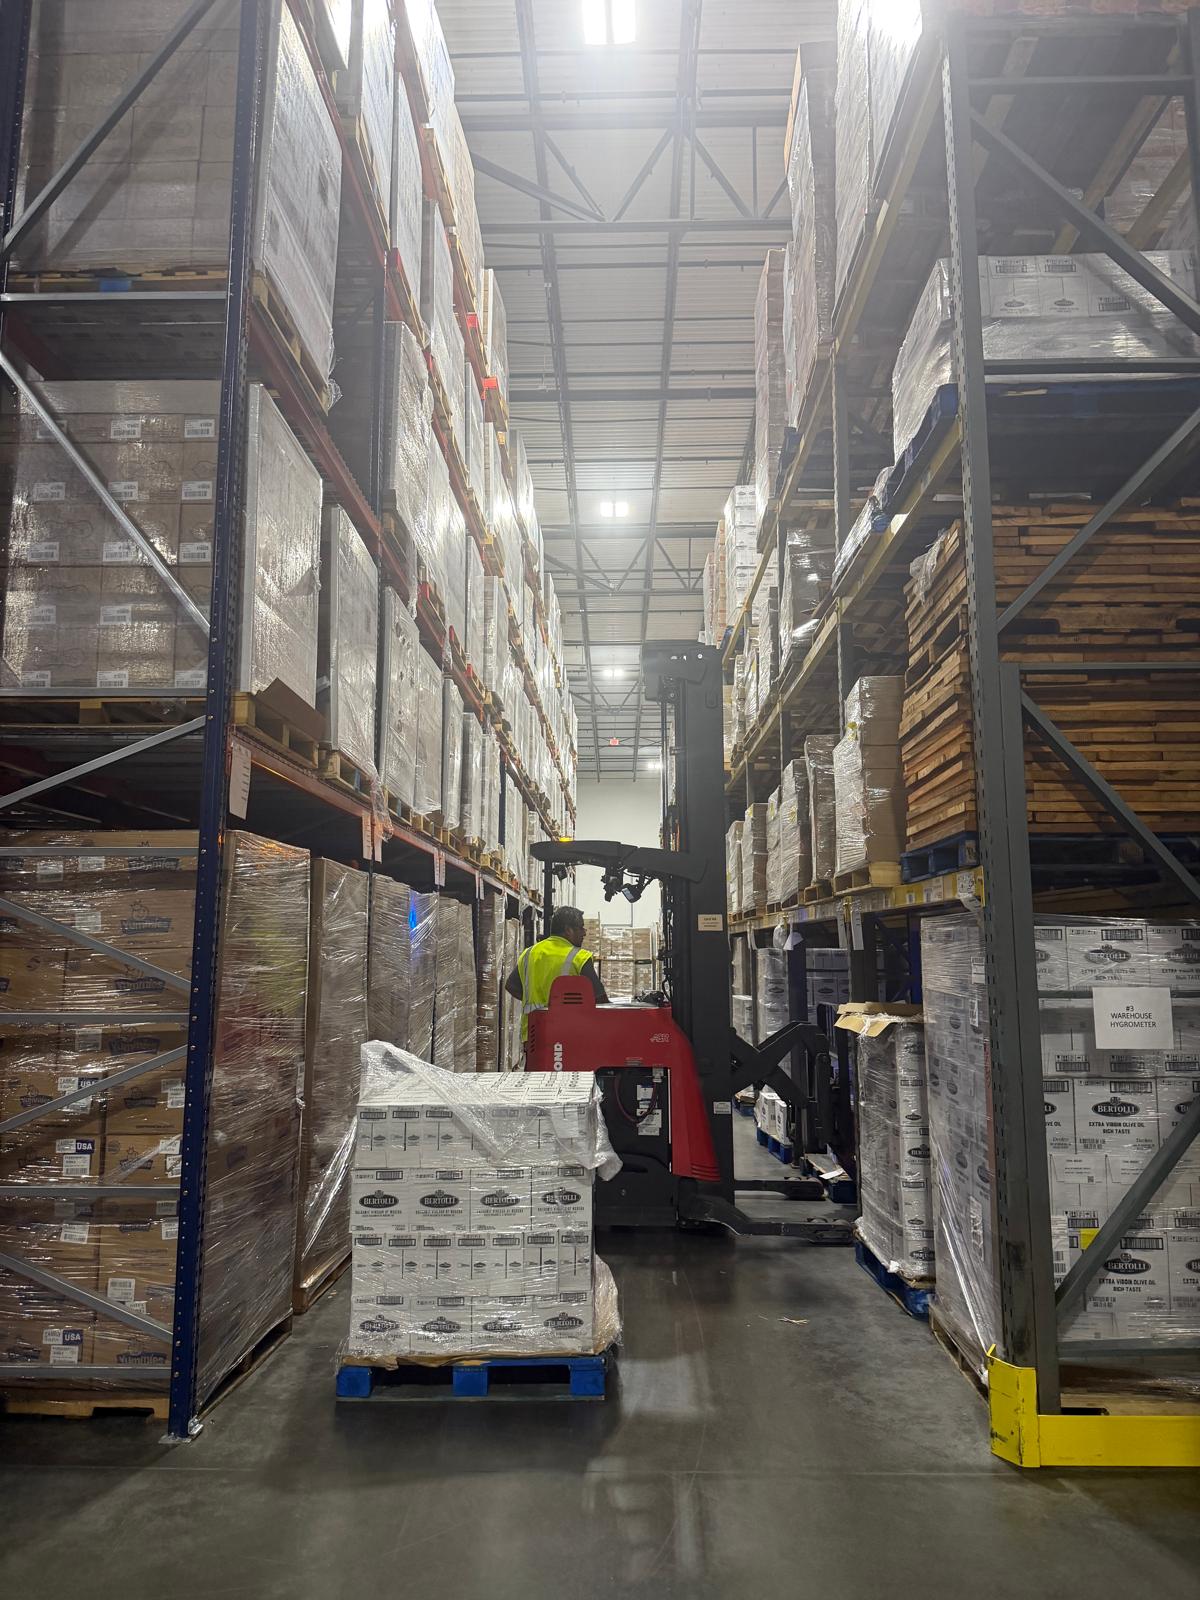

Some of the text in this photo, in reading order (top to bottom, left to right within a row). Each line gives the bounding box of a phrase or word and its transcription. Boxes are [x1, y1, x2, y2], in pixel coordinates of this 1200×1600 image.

[553, 1041, 563, 1071] OND
[1097, 1105, 1136, 1113] BERTOLLI
[76, 1142, 93, 1150] USA
[363, 1197, 395, 1205] BERTOLLI
[424, 1197, 455, 1205] BERTOLLI
[546, 1194, 577, 1202] BETOLLI
[1107, 1262, 1146, 1270] BERTOLLI
[64, 1333, 81, 1341] USA
